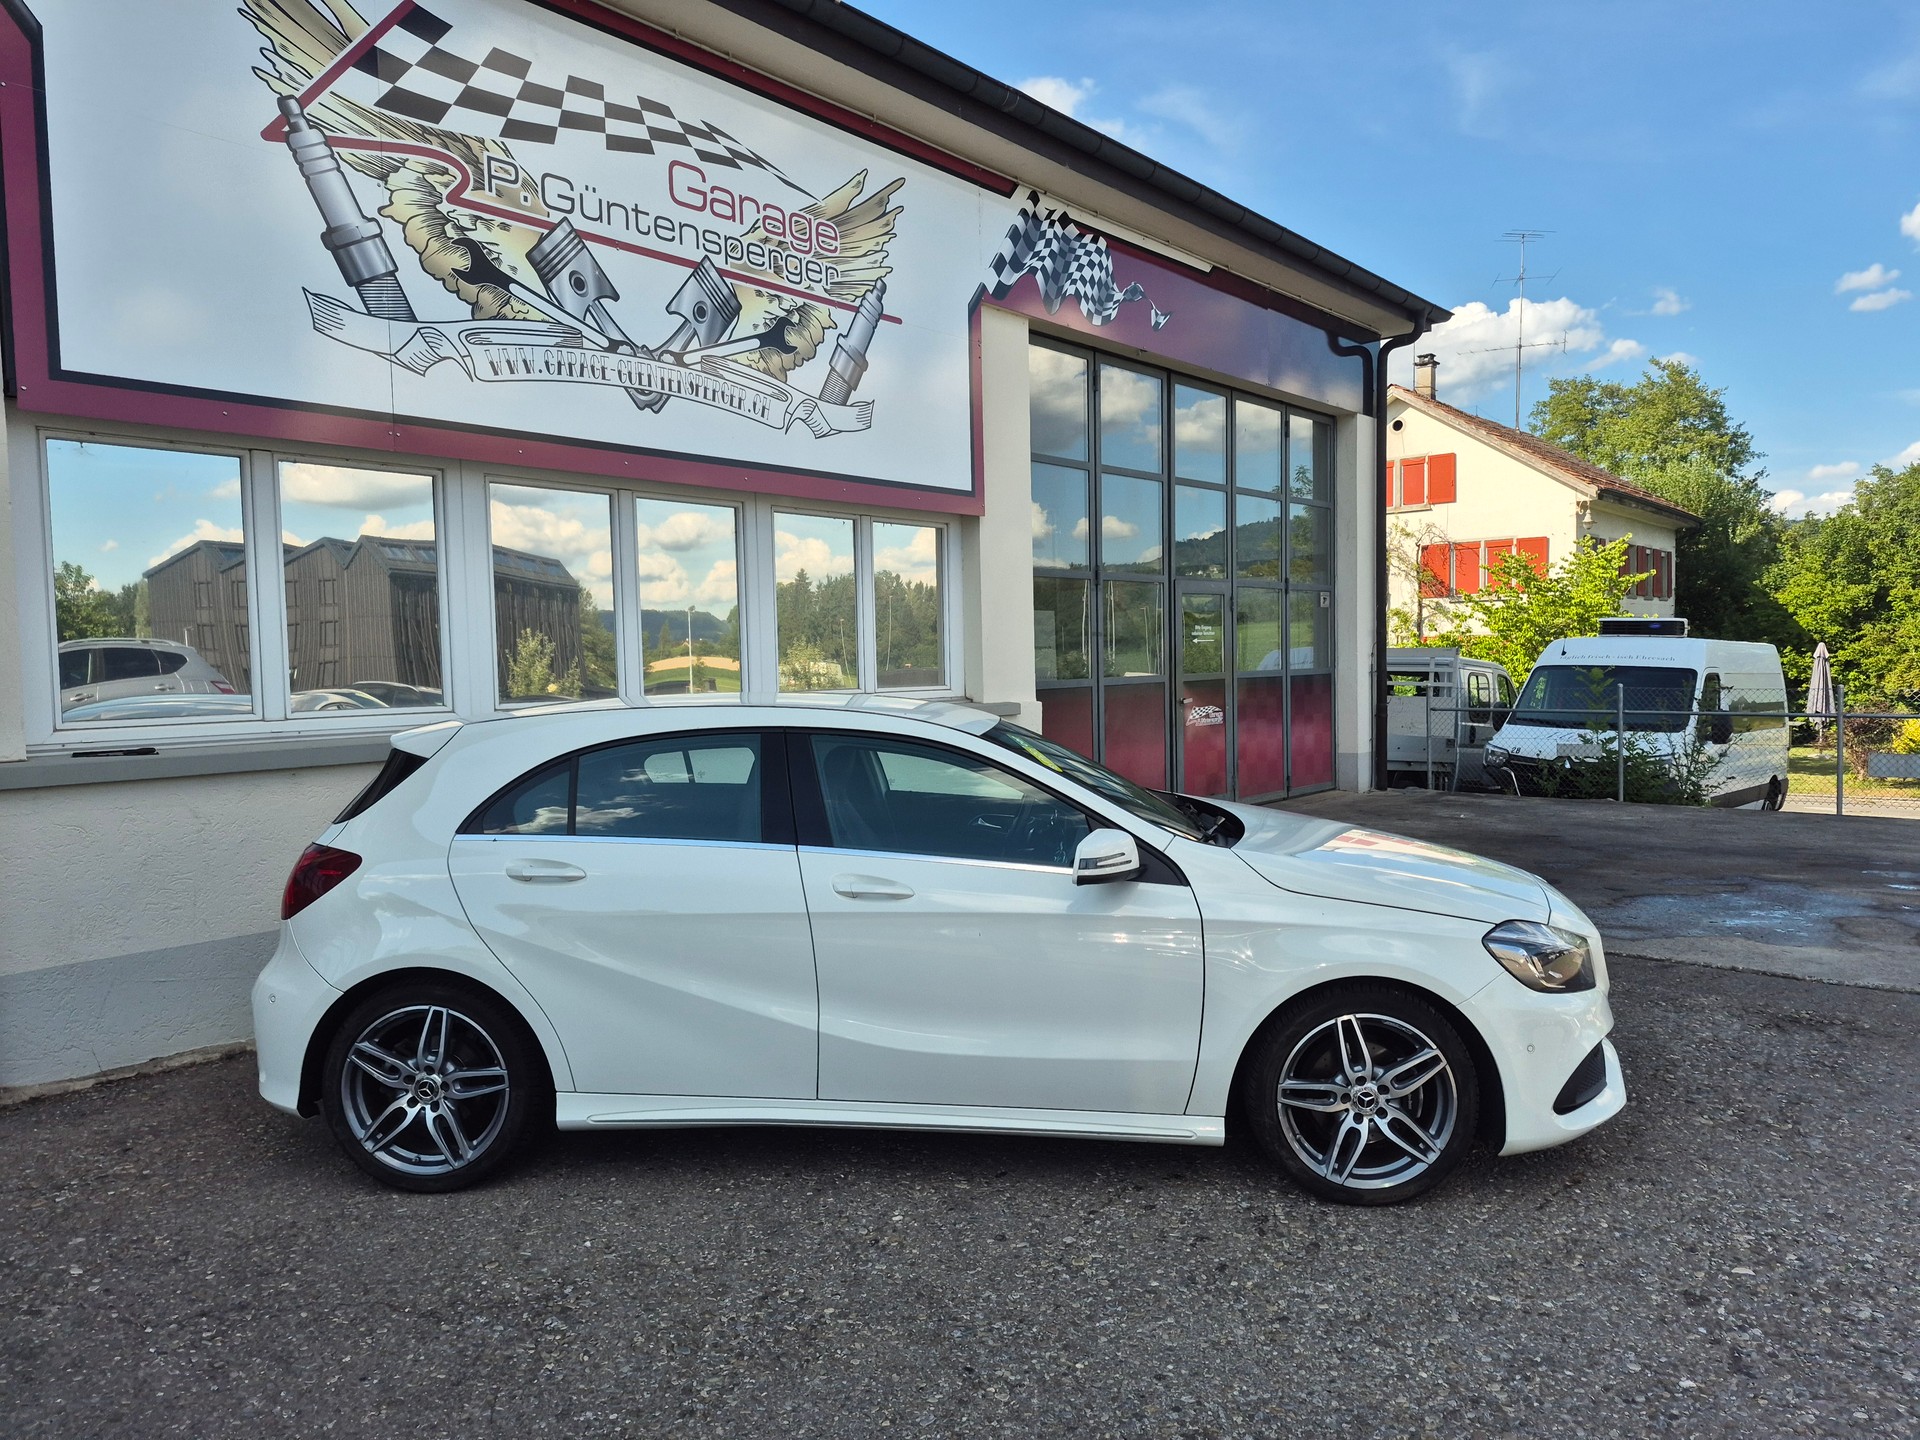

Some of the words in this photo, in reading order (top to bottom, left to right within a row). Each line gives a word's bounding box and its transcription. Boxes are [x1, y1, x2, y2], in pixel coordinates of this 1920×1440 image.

[541, 172, 840, 285] Güntensperger
[668, 159, 840, 255] Garage
[484, 348, 772, 421] WWW.GARAGE-GUENTENSPERGER.CH
